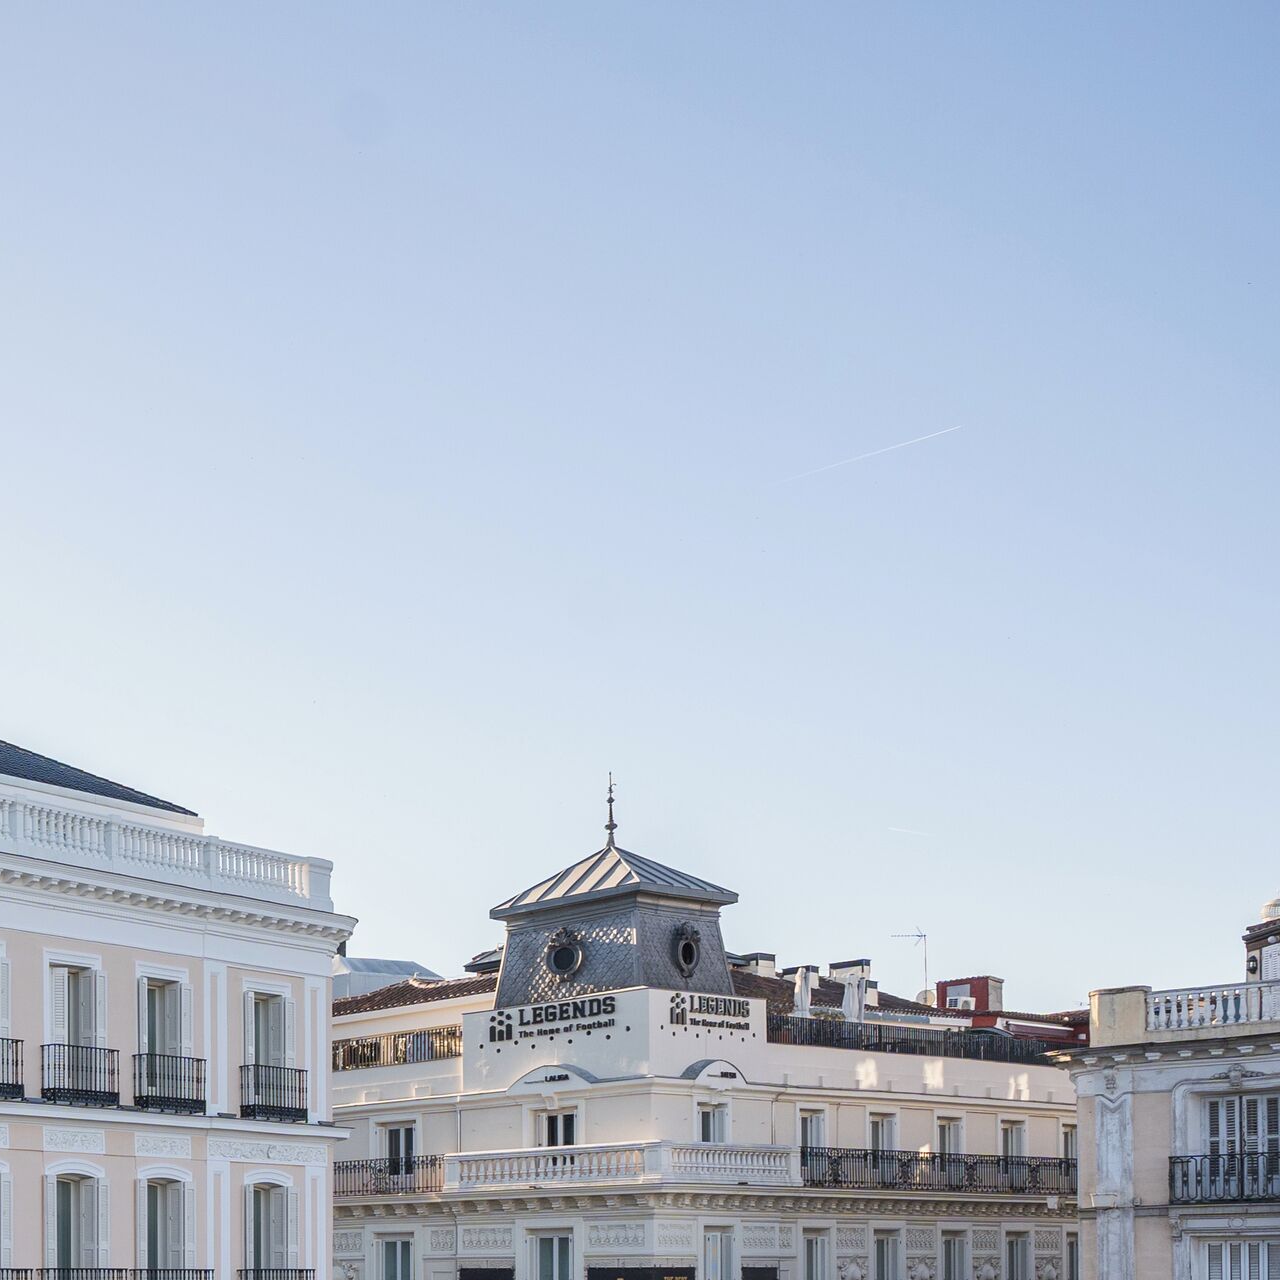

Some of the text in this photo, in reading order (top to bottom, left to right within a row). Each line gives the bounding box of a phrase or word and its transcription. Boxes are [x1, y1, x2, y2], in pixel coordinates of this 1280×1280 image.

[518, 996, 616, 1026] LEGENDS
[689, 995, 750, 1018] LEGENDS
[518, 1018, 615, 1038] The Home of Football
